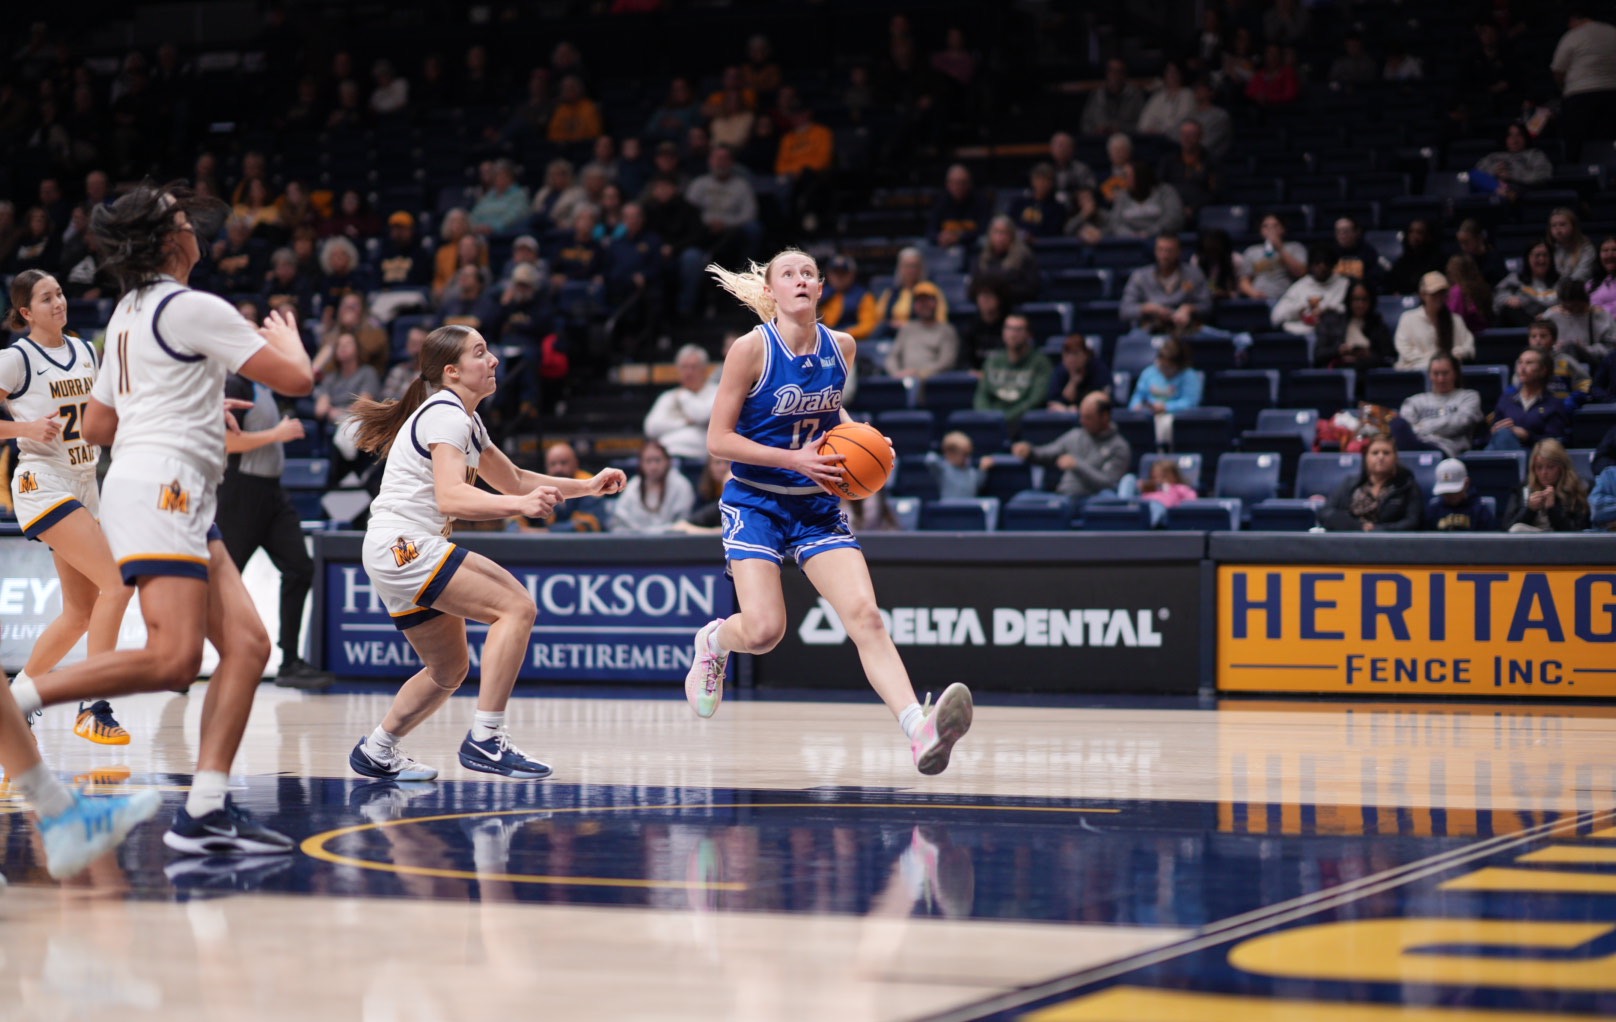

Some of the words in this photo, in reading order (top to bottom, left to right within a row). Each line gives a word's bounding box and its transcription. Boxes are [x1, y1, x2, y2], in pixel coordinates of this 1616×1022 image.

[117, 330, 131, 395] 11
[771, 383, 842, 416] Drake
[790, 418, 820, 449] 17
